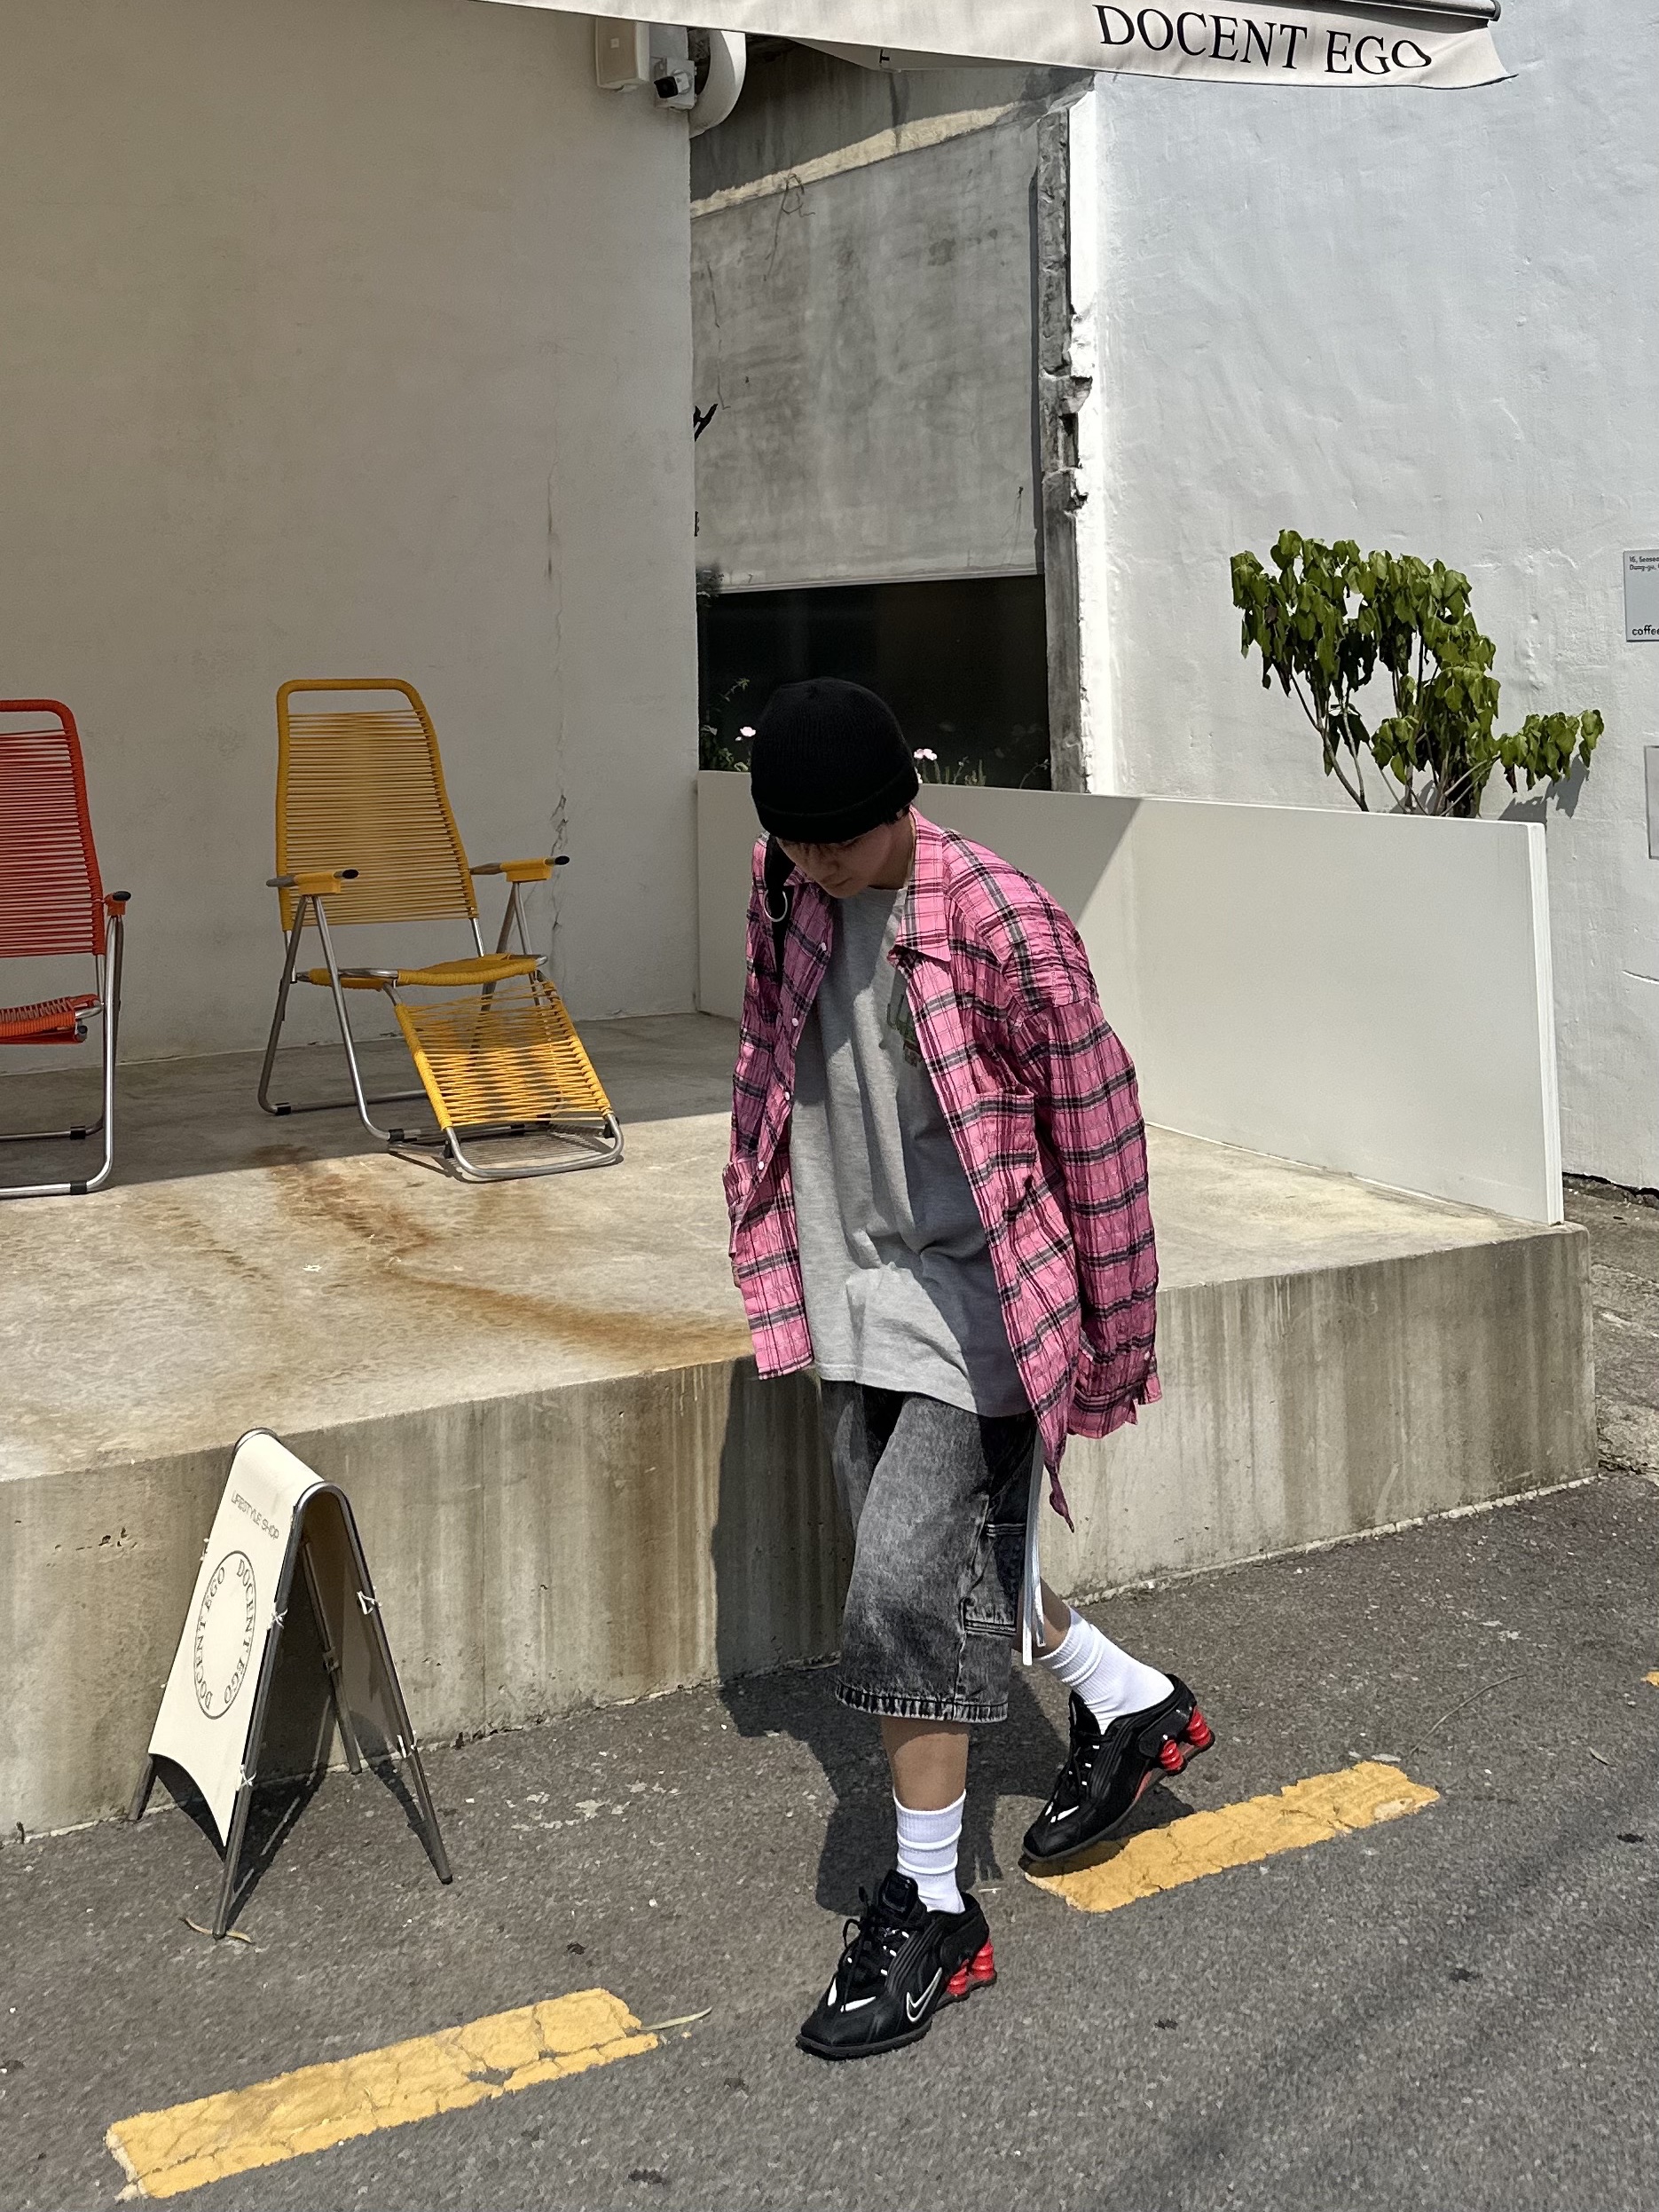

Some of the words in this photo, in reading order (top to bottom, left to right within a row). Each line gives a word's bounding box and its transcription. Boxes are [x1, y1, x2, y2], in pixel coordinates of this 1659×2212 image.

[1092, 4, 1308, 69] DOCENT
[1325, 29, 1432, 75] EGO
[231, 1490, 262, 1526] LIFESTYLE
[261, 1518, 279, 1539] SHOP
[204, 1567, 225, 1612] EGO
[236, 1558, 254, 1653] DOCENT
[195, 1616, 214, 1711] DOCENT
[224, 1657, 245, 1704] EGO
